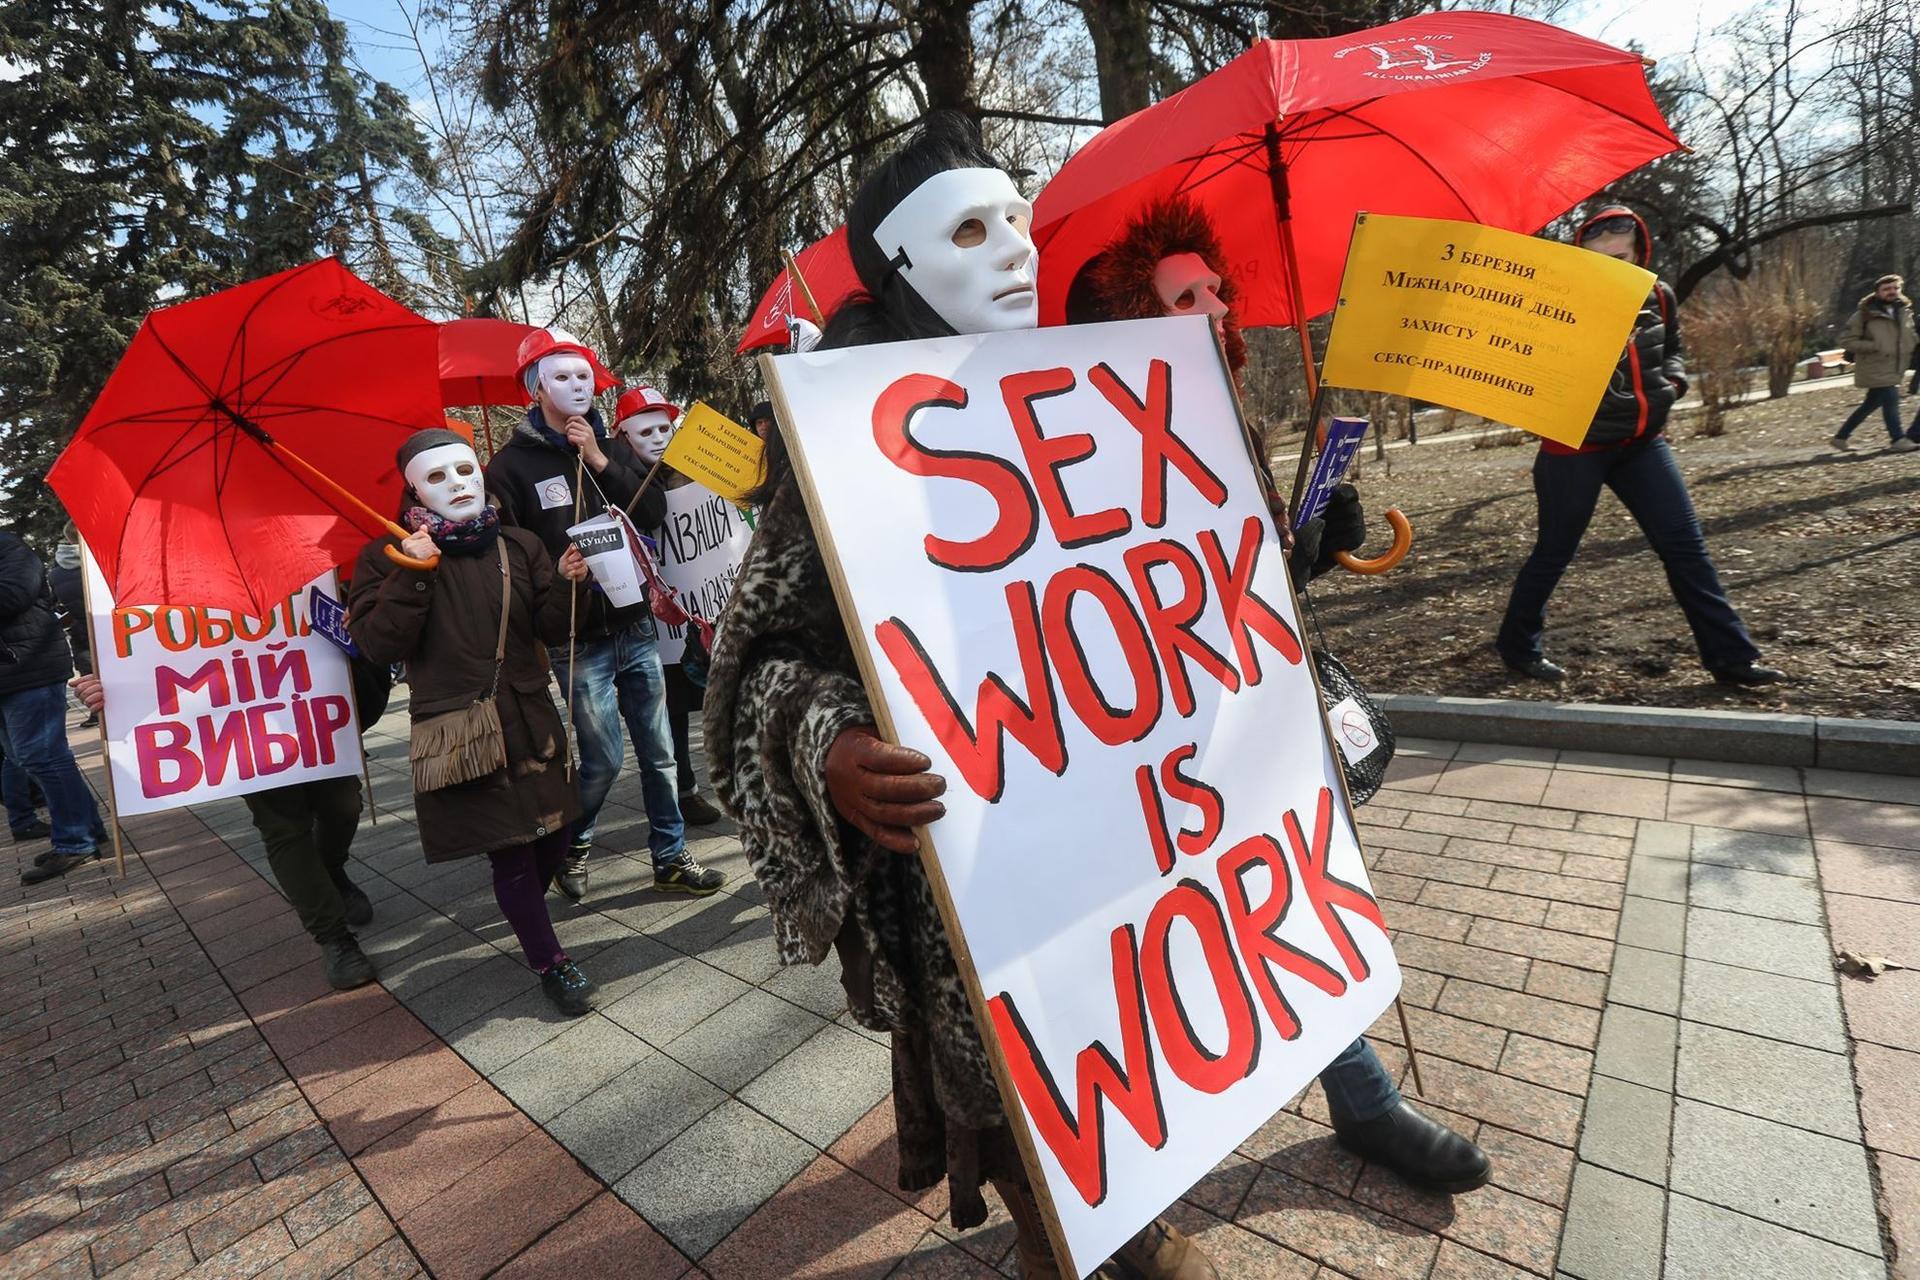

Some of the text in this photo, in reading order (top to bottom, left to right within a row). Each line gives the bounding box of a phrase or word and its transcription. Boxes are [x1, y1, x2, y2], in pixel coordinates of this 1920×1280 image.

[1440, 243, 1456, 262] 3
[1460, 251, 1537, 279] БЕРЕЗНЯ
[1400, 317, 1479, 341] ЗАХИСТУ
[1488, 334, 1534, 357] ПРАВ
[1528, 302, 1577, 325] ДЕНЬ
[1373, 351, 1536, 397] СЕКС-ПРАЦІВНИКІВ
[872, 358, 1229, 573] SEX
[579, 533, 618, 549] КУпАП
[112, 588, 312, 658] РОБОТ
[874, 516, 1303, 803] WORK
[134, 693, 351, 799] ВИБІР
[1134, 742, 1225, 876] IS
[986, 785, 1389, 1208] WORK
